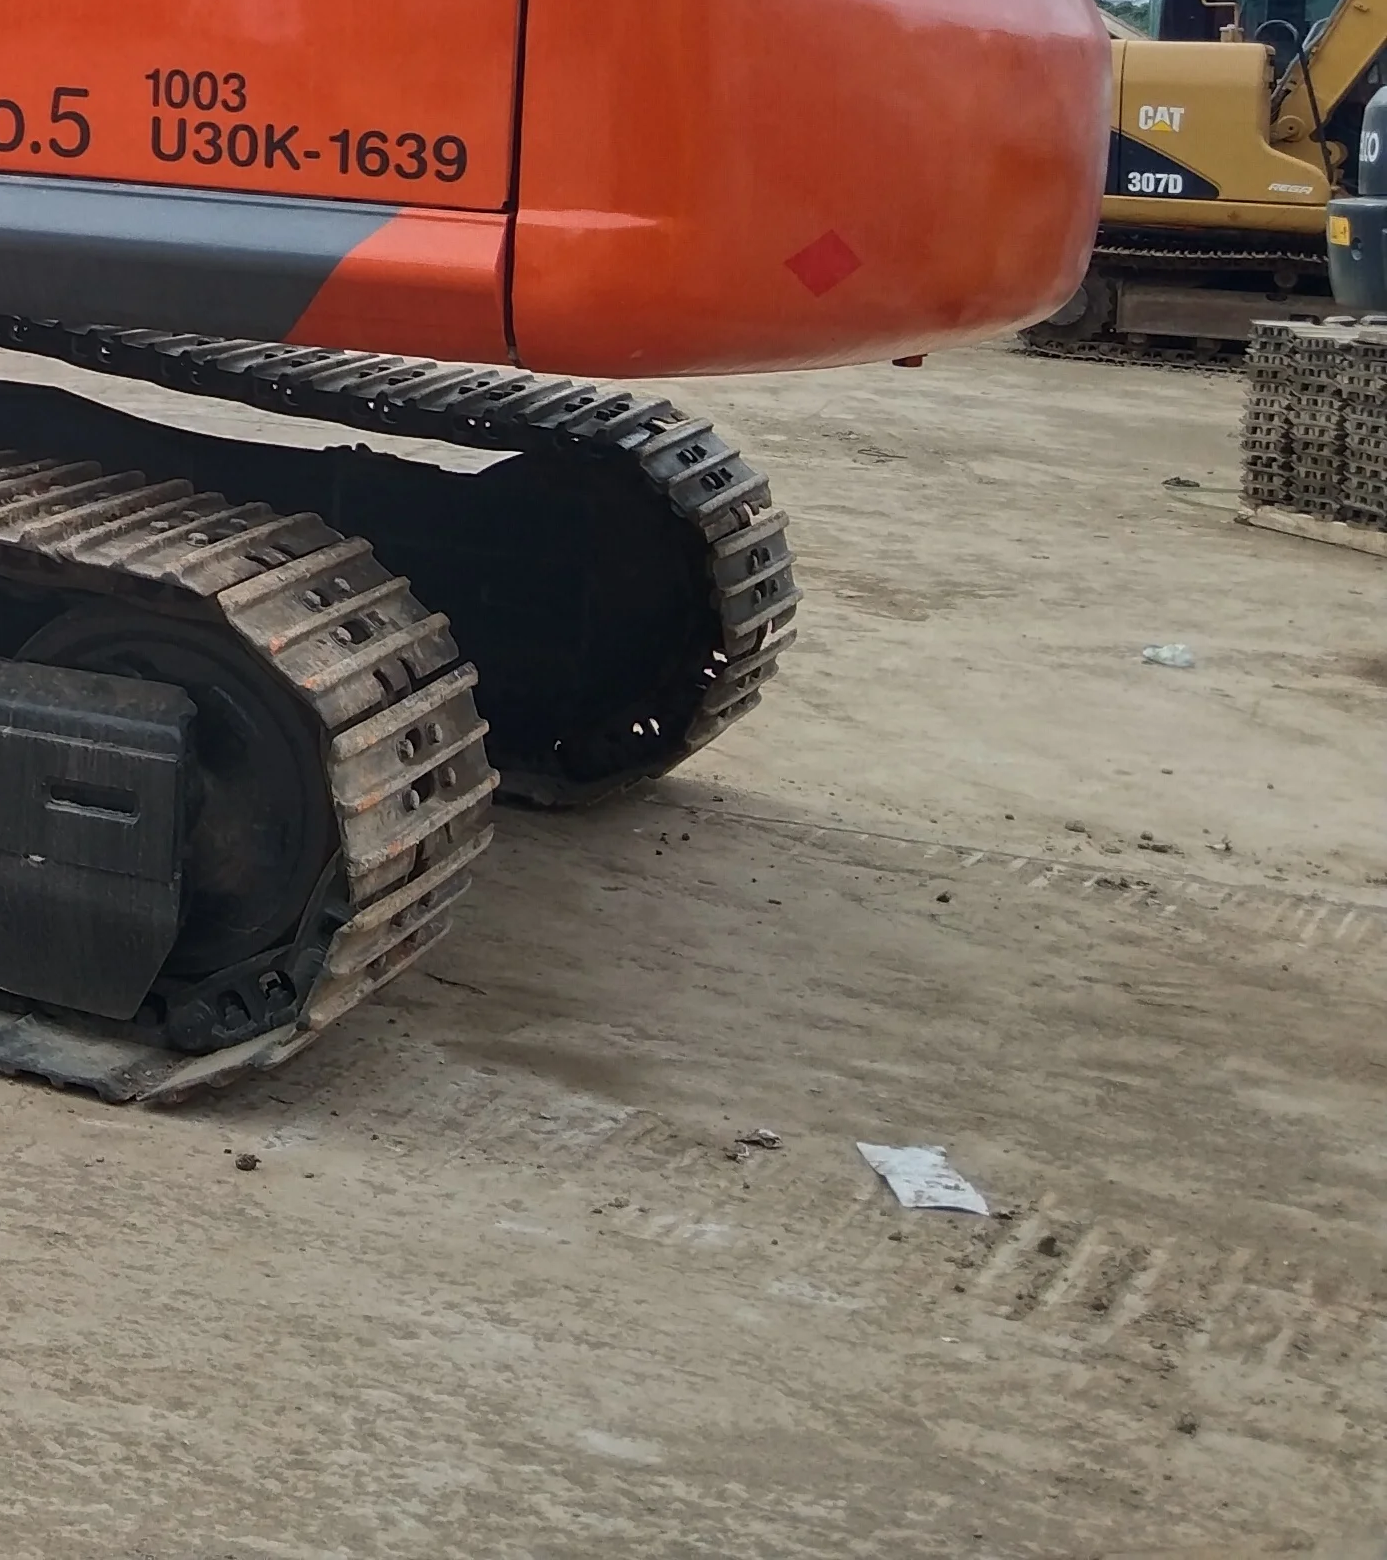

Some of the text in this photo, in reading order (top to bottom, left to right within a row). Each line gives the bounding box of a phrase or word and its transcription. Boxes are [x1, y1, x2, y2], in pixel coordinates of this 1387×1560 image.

[144, 68, 248, 113] 1003
[1138, 105, 1185, 132] CAT
[151, 115, 469, 184] U30K-1639
[1127, 171, 1183, 194] 307D
